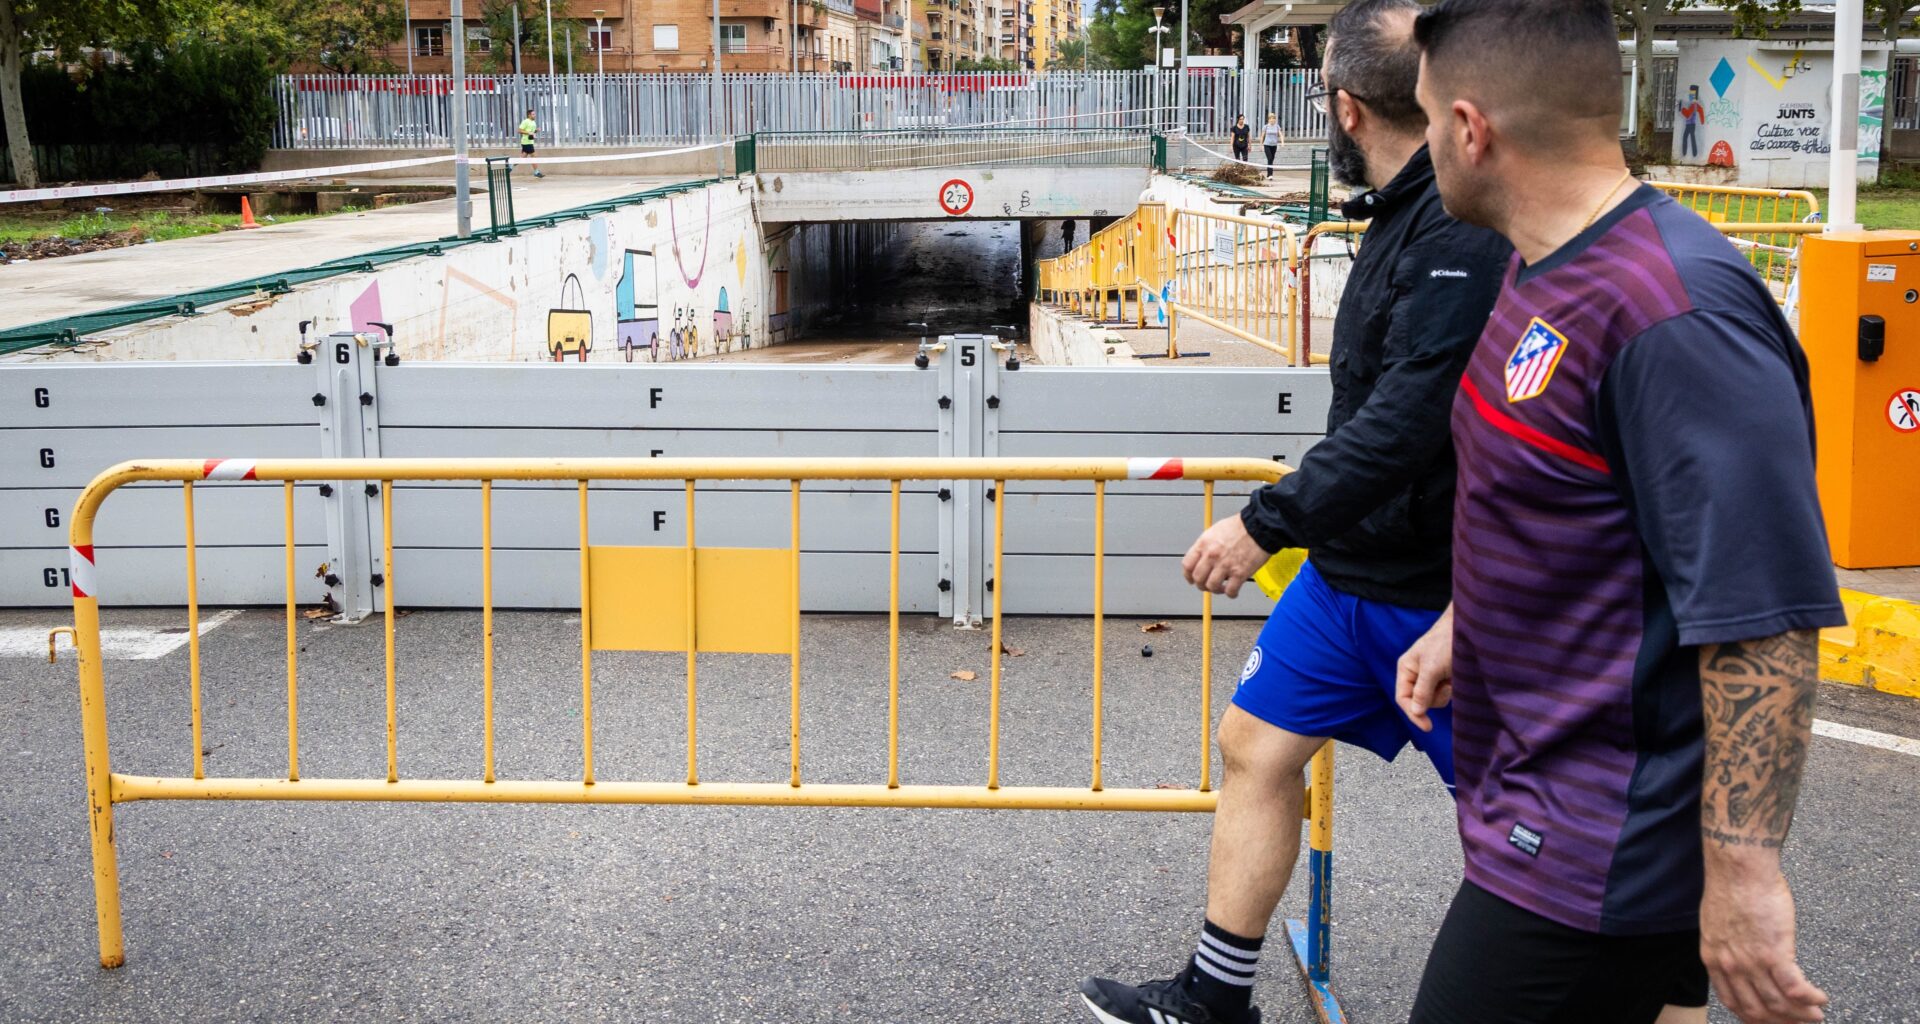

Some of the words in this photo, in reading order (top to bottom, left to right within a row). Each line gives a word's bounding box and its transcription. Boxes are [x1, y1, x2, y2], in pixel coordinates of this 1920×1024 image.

[1776, 109, 1815, 119] JUNTS
[1757, 123, 1794, 137] Cultura
[336, 344, 350, 363] 6
[961, 346, 975, 366] 5
[35, 388, 50, 408] G
[650, 389, 663, 408] F
[1278, 393, 1292, 413] E
[40, 449, 55, 468] G
[45, 508, 60, 528] G
[653, 511, 666, 531] F
[44, 568, 70, 587] G1
